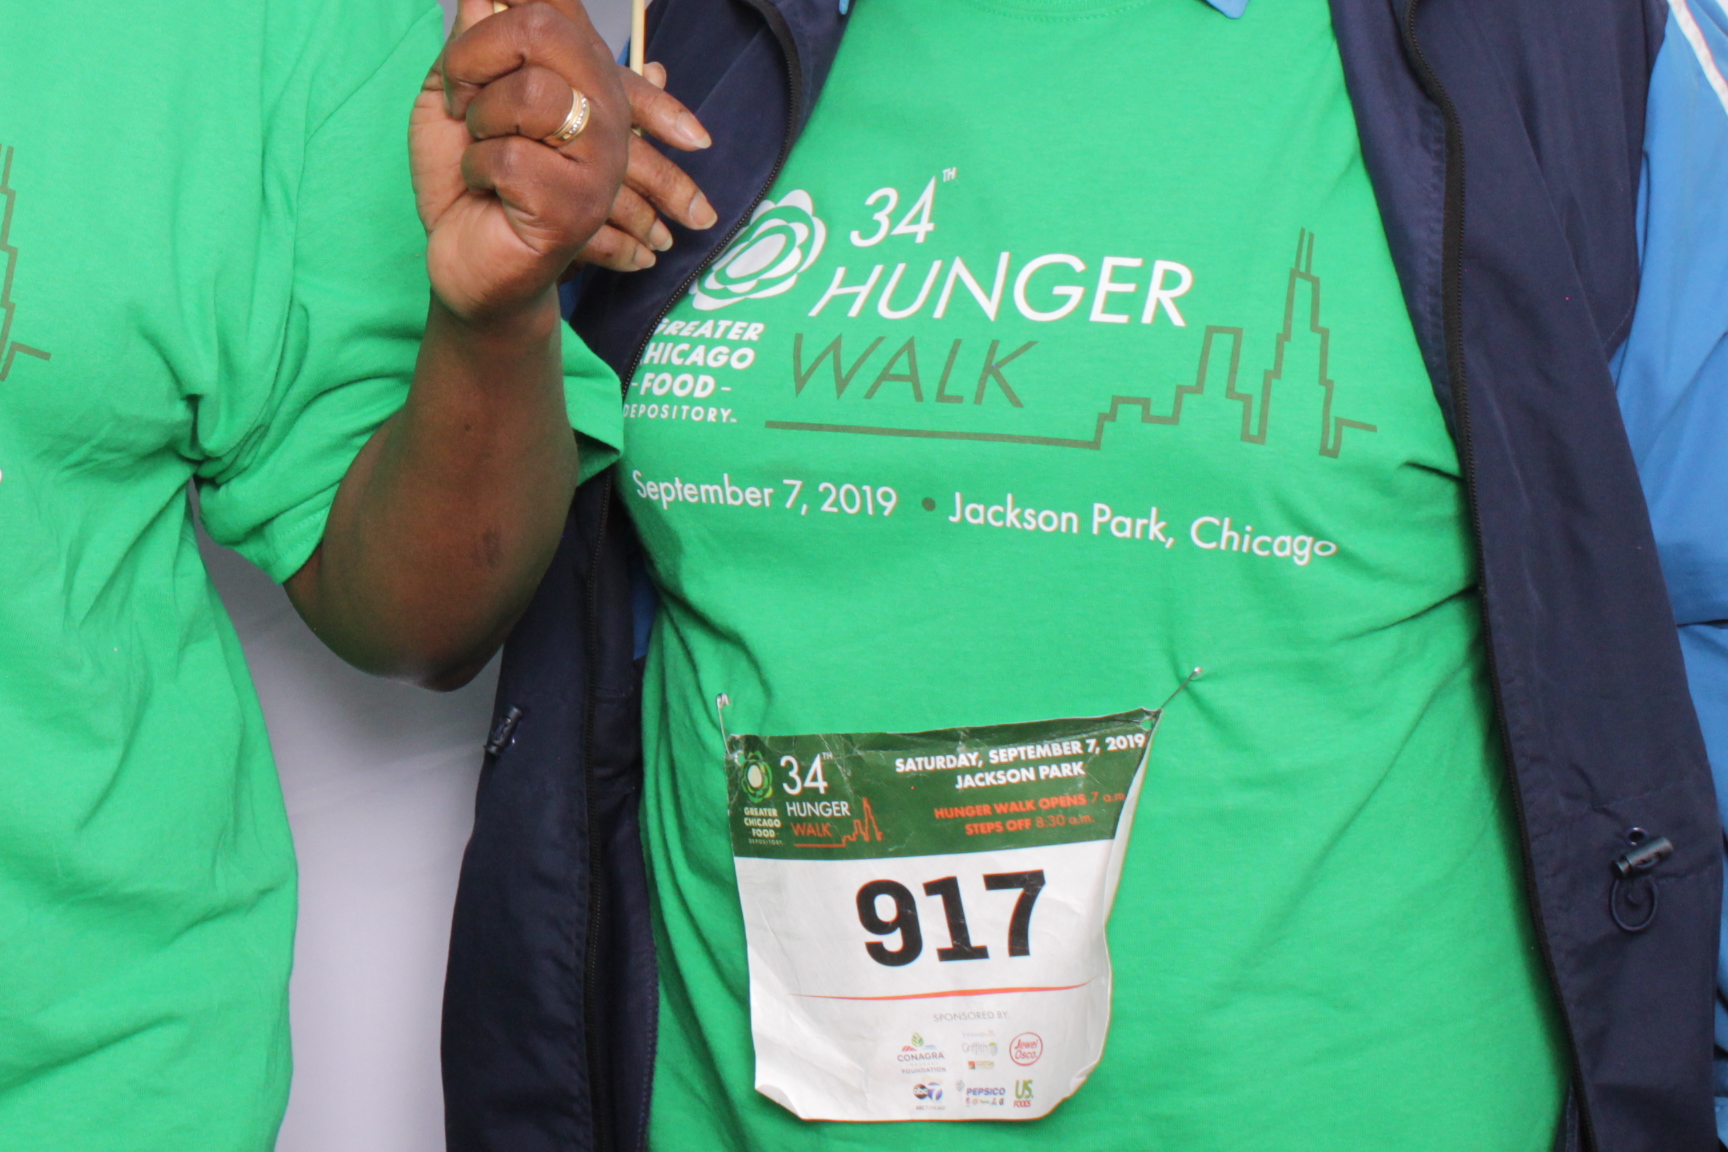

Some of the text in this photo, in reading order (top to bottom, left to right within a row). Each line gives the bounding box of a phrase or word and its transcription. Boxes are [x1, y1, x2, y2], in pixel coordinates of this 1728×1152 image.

[808, 250, 1194, 328] HUNGER
[639, 342, 756, 370] HICAGO
[792, 332, 1039, 409] WALK
[632, 469, 1339, 567] September 7, 2019 Jackson Park, Chicago
[895, 733, 1147, 773] SATURDAY, SEPTEMBER 7, 2019
[954, 761, 1087, 790] JACKSON PARK
[743, 807, 778, 817] GREATER
[785, 801, 852, 817] HUNGER
[934, 803, 993, 819] HUNGER
[993, 799, 1037, 815] WALK
[1038, 793, 1088, 810] OPENS
[1090, 791, 1100, 804] 7
[743, 817, 782, 828] CHICAGO
[791, 822, 833, 837] WALK
[965, 821, 1004, 836] STEPS
[1005, 818, 1032, 832] OFF
[1035, 814, 1066, 829] 8:30
[855, 868, 1046, 968] 917
[933, 1011, 994, 1022] SPONSORED
[897, 1051, 945, 1062] CONAGRA
[966, 1087, 1006, 1096] PEPSICO
